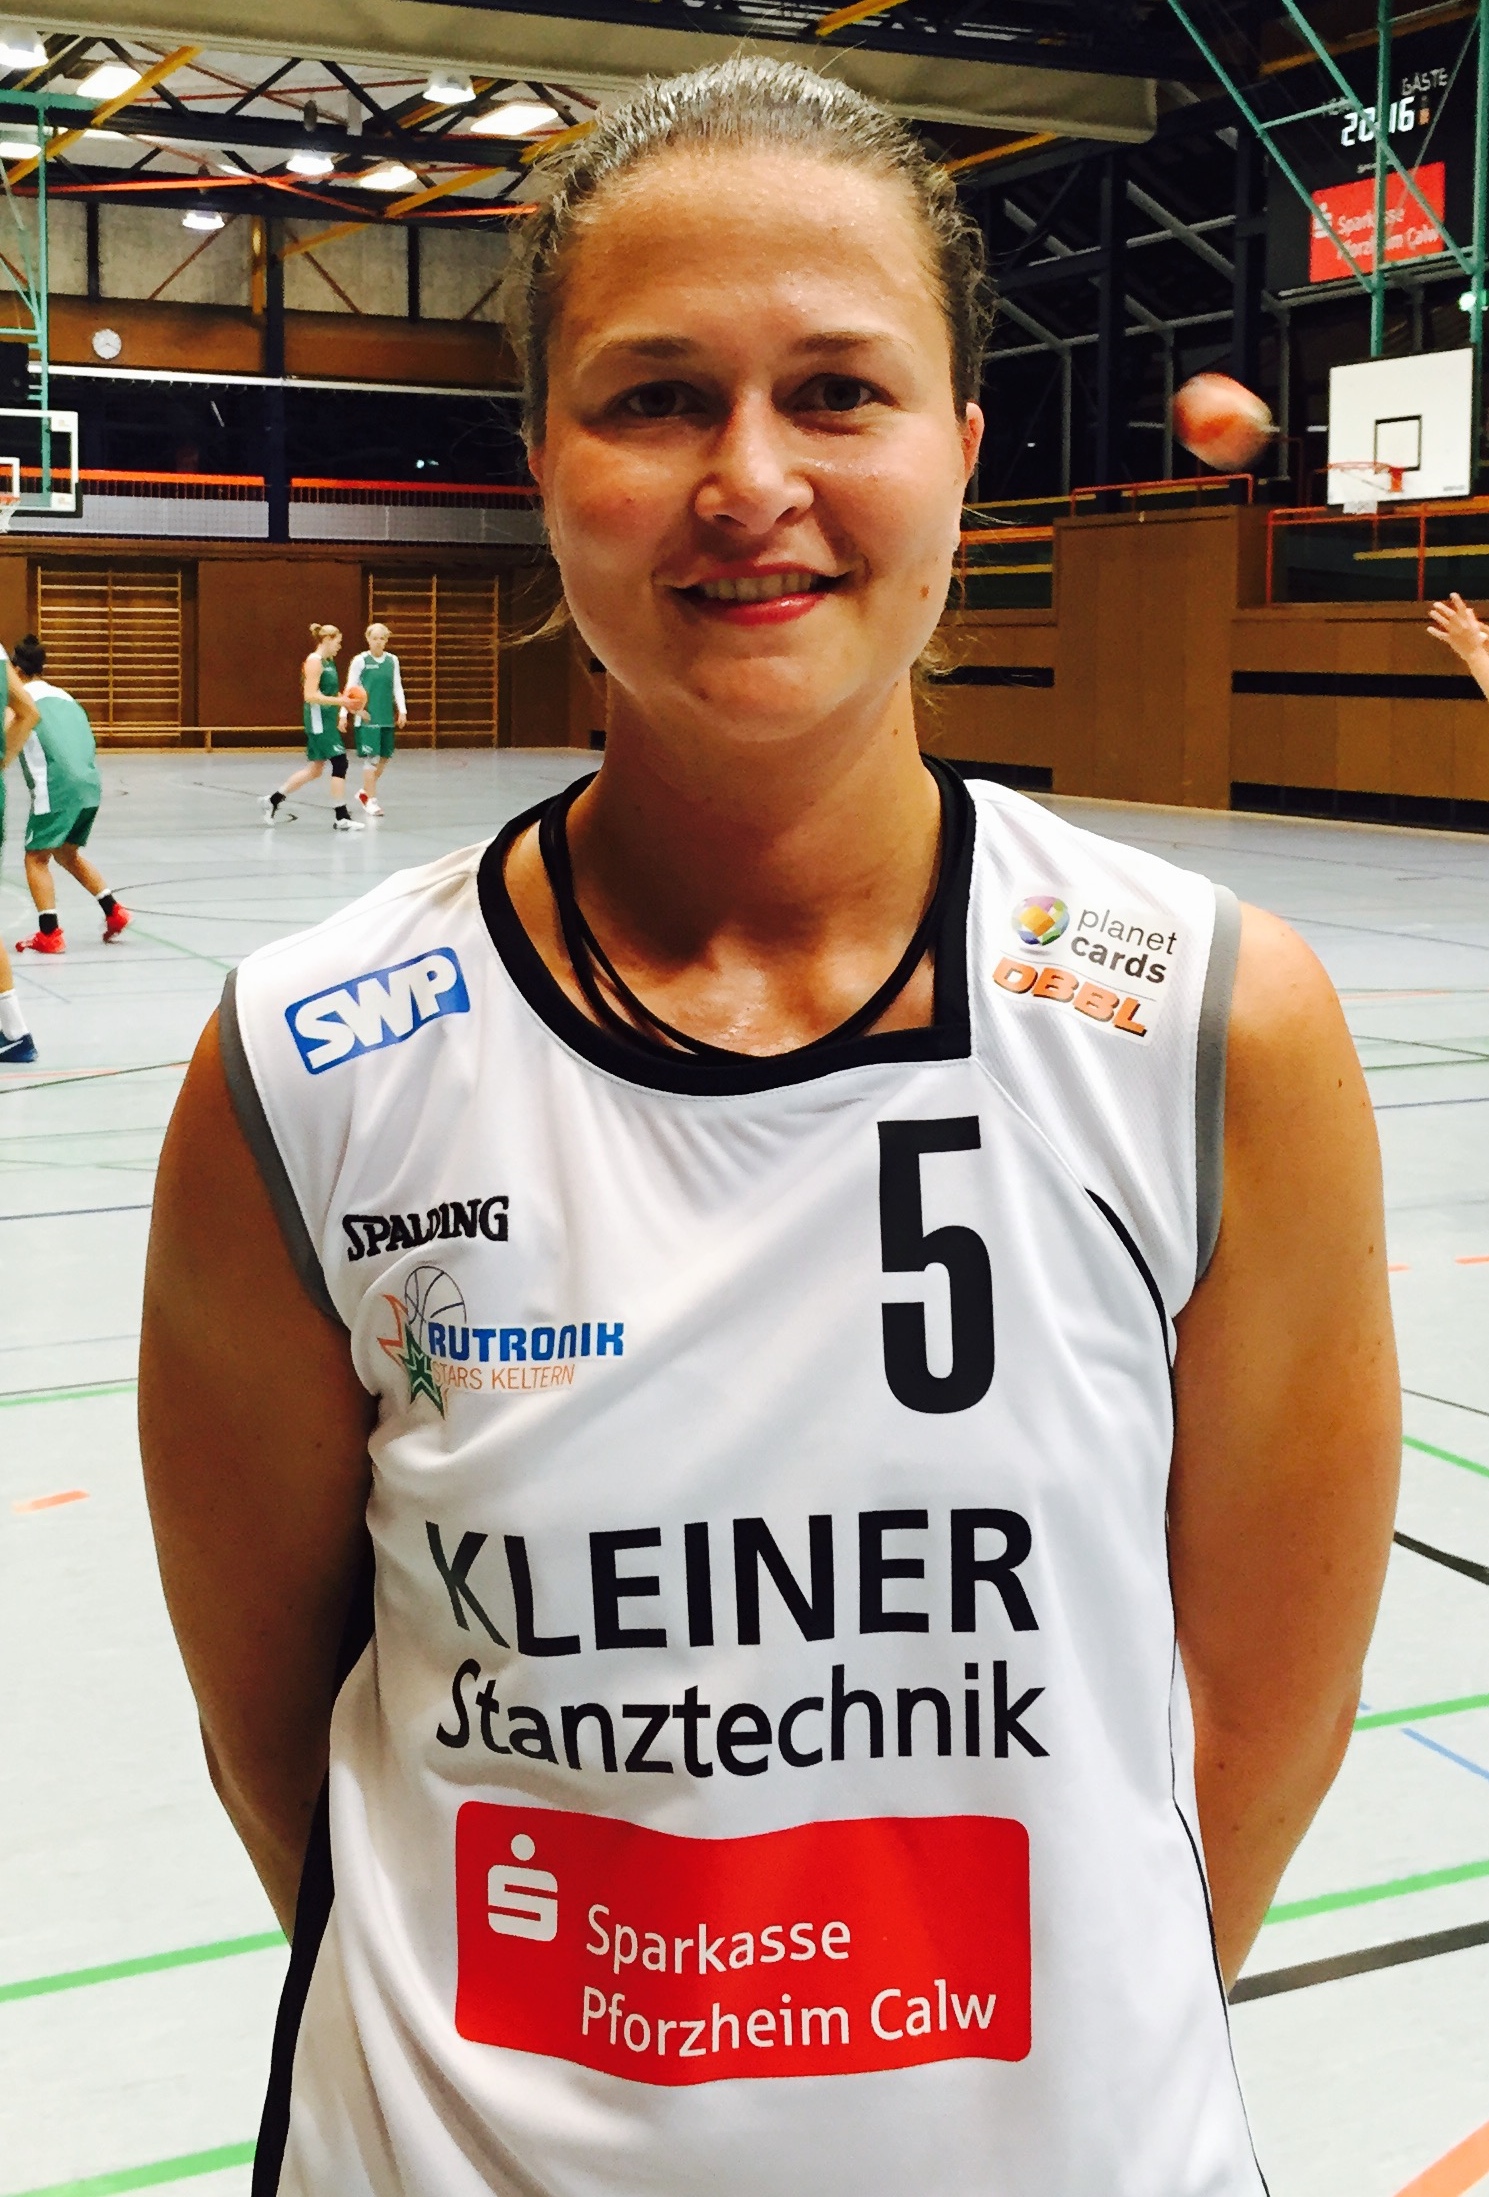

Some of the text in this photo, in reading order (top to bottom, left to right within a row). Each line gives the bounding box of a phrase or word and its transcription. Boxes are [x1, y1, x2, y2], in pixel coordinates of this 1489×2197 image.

[1337, 208, 1406, 237] Sparksse
[1071, 936, 1168, 984] cards
[1077, 909, 1177, 954] planet
[295, 953, 458, 1070] SWP
[992, 956, 1147, 1037] DBBL
[342, 1195, 509, 1262] SPALDING
[877, 1115, 995, 1414] 5
[427, 1321, 624, 1363] RUTRONIK
[431, 1361, 576, 1390] STARS KELTERN
[425, 1508, 1040, 1657] KLEINER
[436, 1658, 1051, 1778] Stanztechnik
[585, 1903, 852, 1975] Sparkasse
[581, 1979, 997, 2058] Pforzheim Calw
